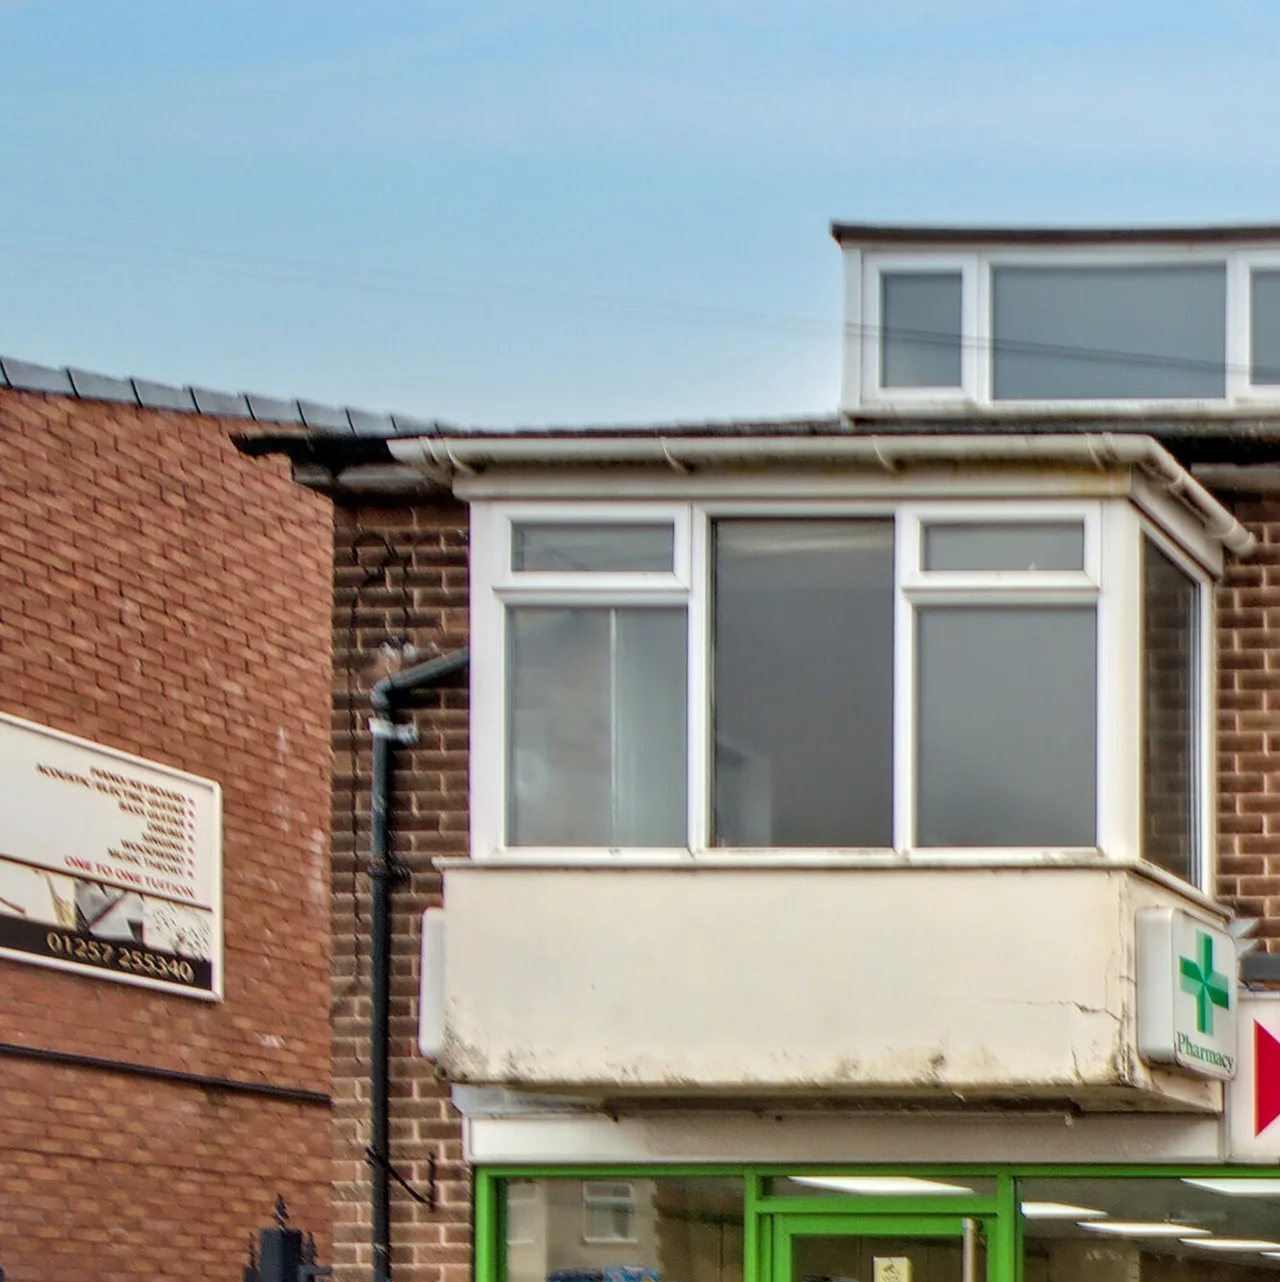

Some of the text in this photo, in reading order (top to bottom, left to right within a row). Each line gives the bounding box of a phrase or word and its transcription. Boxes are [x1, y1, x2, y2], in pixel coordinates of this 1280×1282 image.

[47, 932, 195, 983] 01257 255340
[1177, 1031, 1235, 1074] Pharmacy
